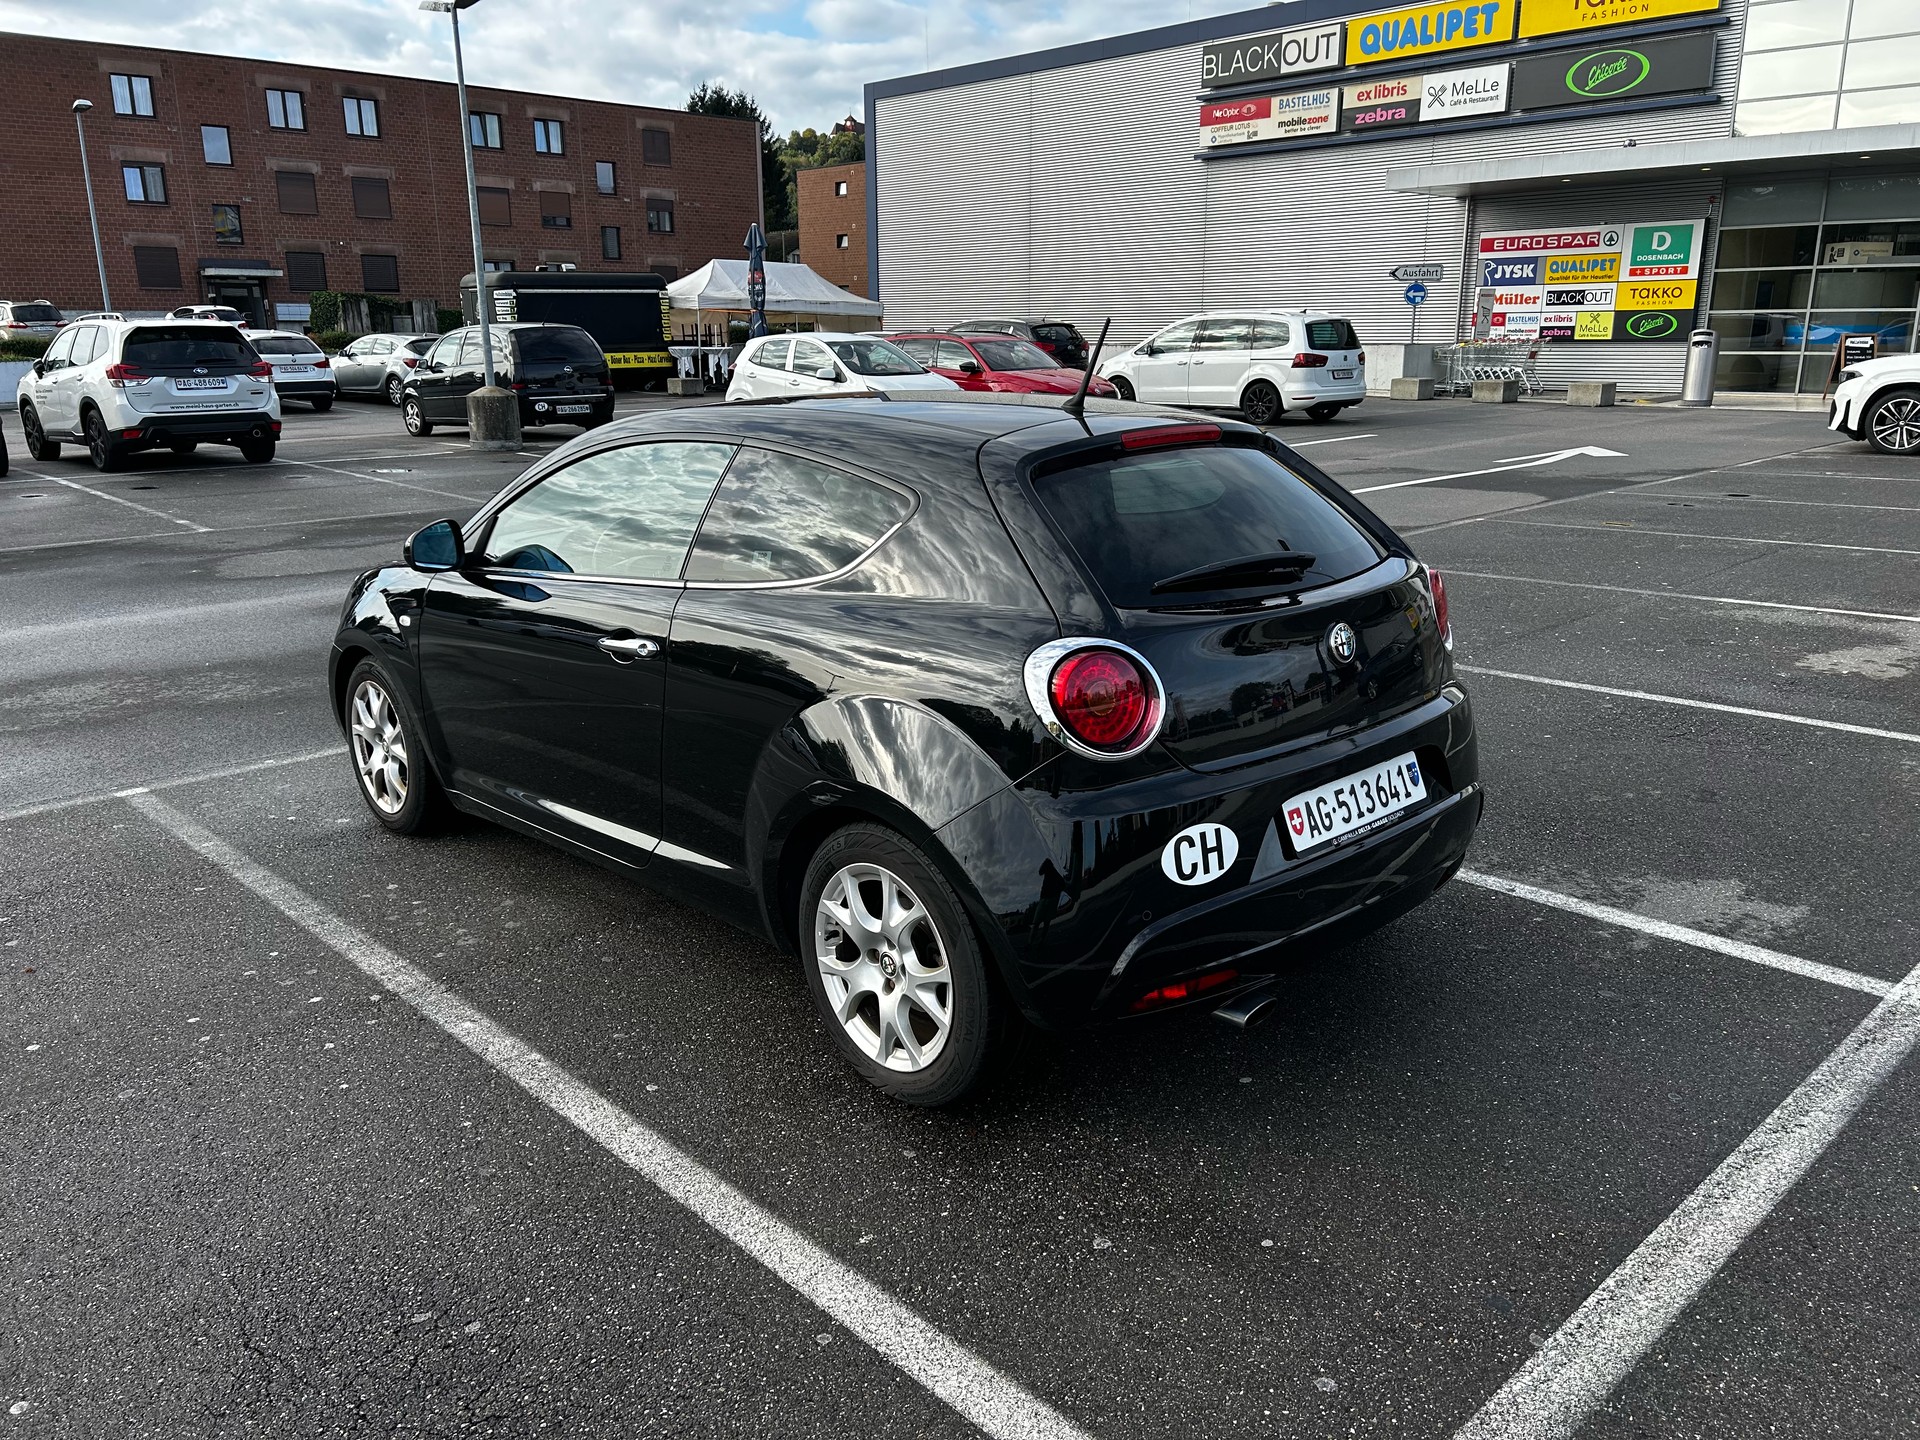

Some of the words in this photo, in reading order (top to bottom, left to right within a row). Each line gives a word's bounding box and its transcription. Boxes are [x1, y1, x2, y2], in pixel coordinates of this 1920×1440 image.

[1582, 4, 1649, 22] FASHION
[1360, 2, 1500, 55] QUALIPET
[1357, 90, 1372, 102] ex
[1374, 82, 1408, 100] libris
[1451, 78, 1500, 97] MeLLe
[1278, 92, 1331, 109] BASTELHUS
[1450, 98, 1462, 107] Café
[1468, 94, 1500, 104] Restaurant
[1277, 114, 1329, 128] mobilezone
[1355, 107, 1407, 125] zebra
[1210, 124, 1234, 134] COIFFEUR
[1234, 122, 1251, 131] LOTUS
[1493, 234, 1599, 250] EUROSPAR
[1652, 231, 1672, 251] D
[1636, 253, 1684, 261] DOSENBACH
[1402, 269, 1439, 277] Ausfahrt
[1494, 264, 1536, 279] JYSK
[1549, 258, 1617, 274] QUALIPET
[1494, 293, 1540, 305] Müller
[1542, 328, 1572, 336] zebra
[1579, 324, 1608, 332] MeLLe
[1173, 827, 1225, 881] CH
